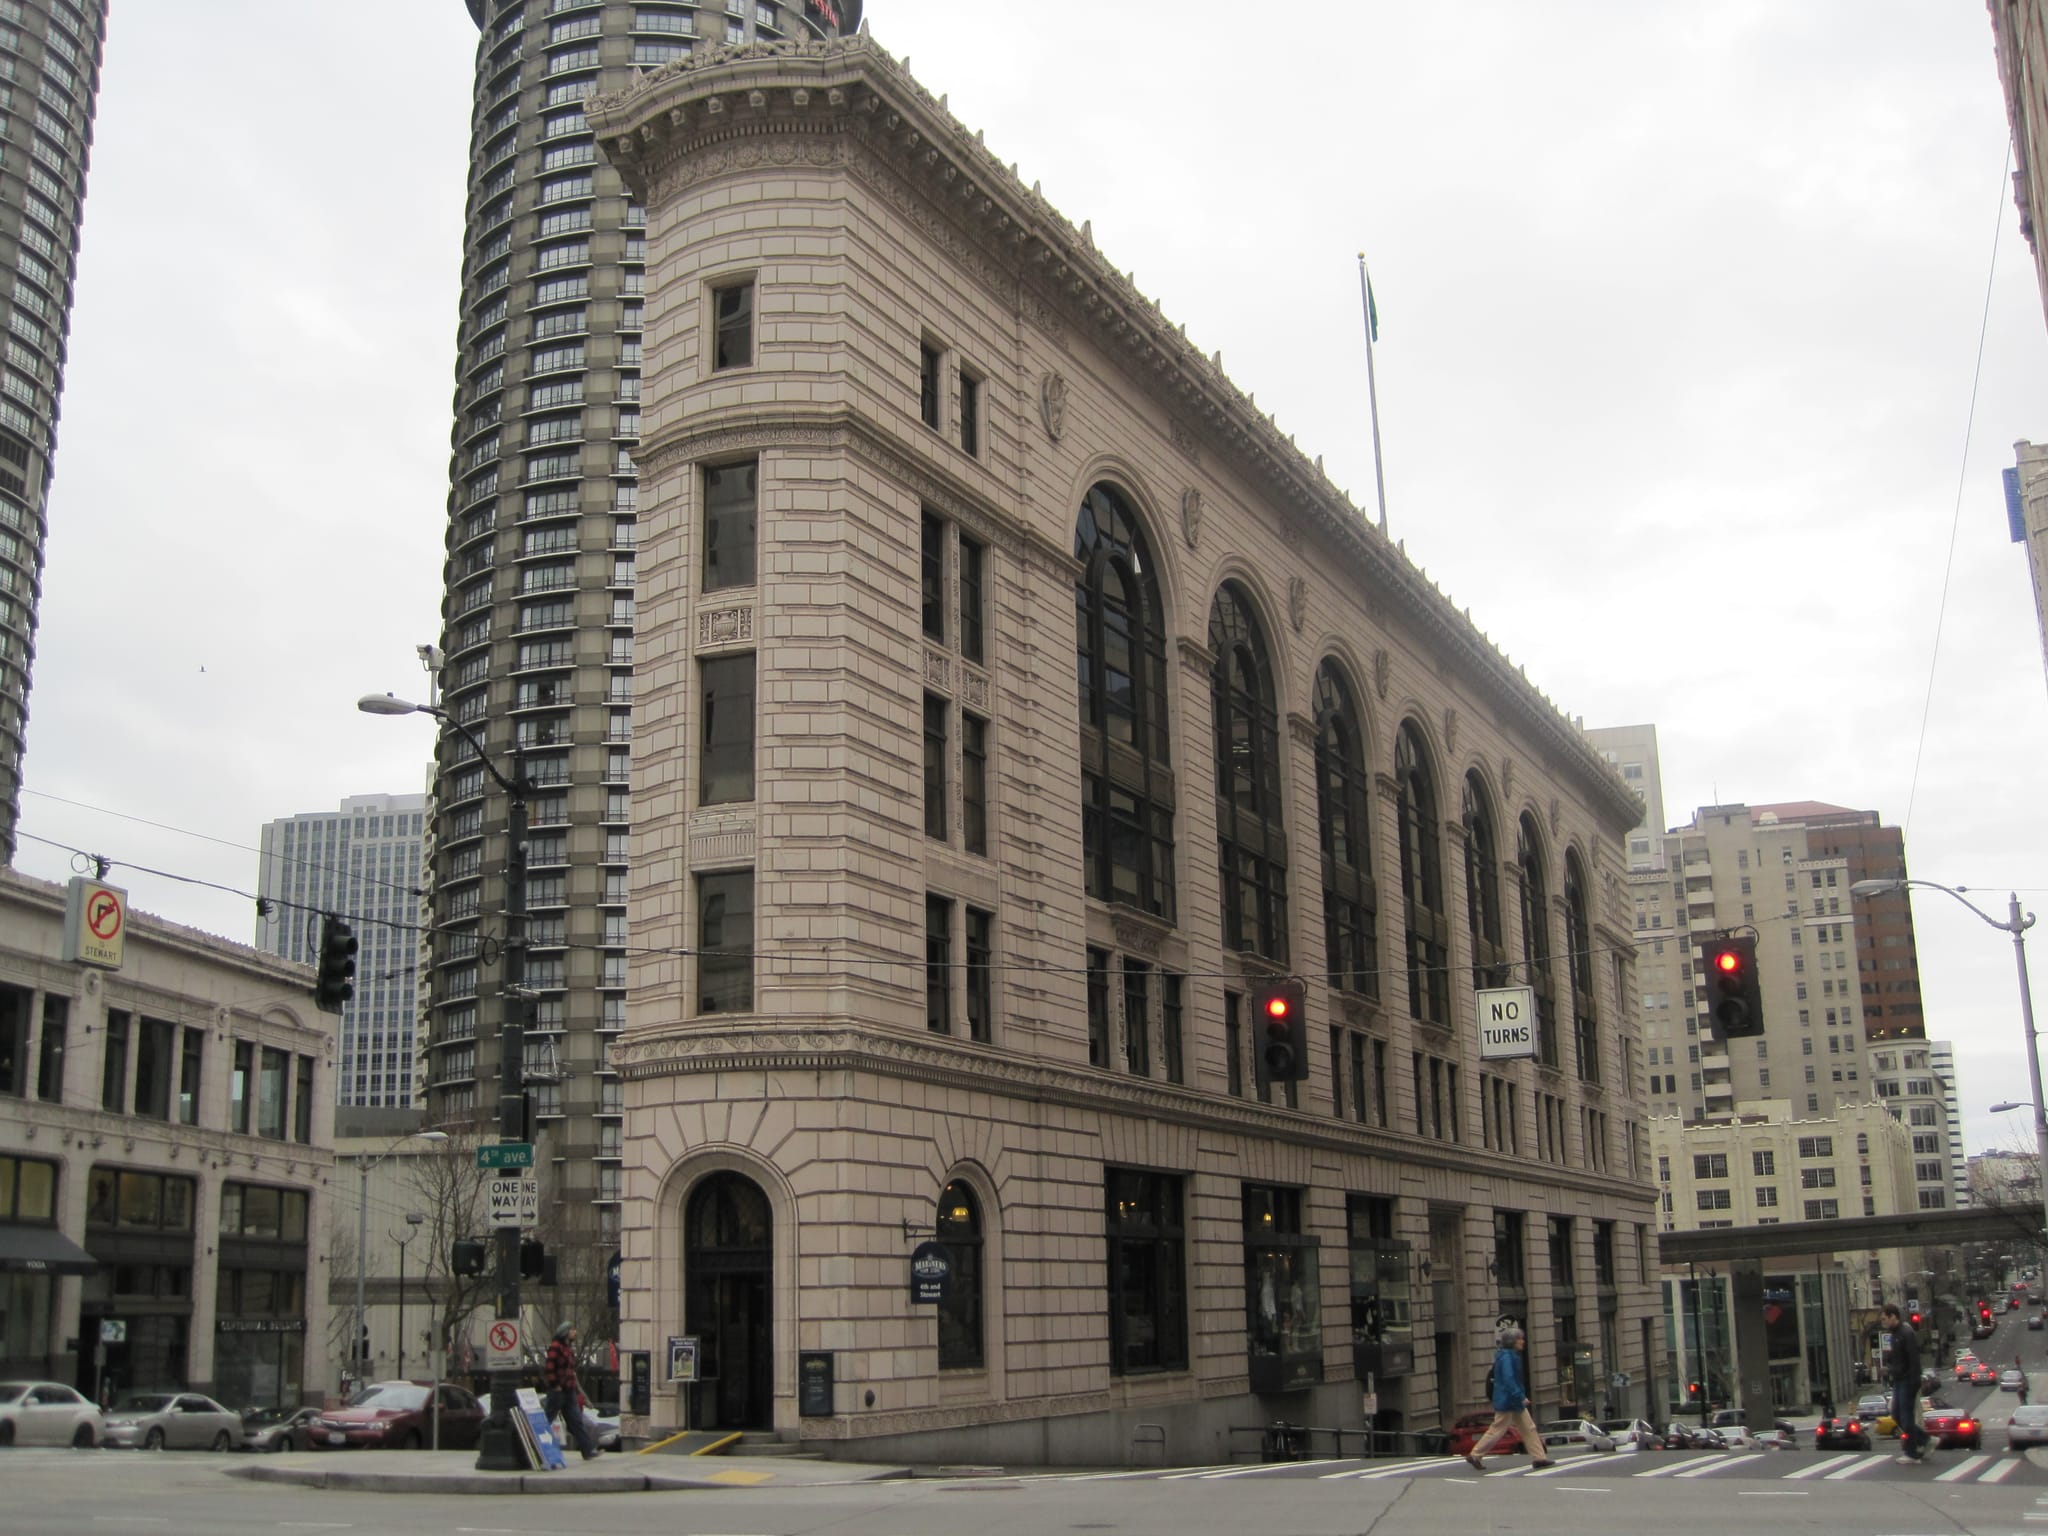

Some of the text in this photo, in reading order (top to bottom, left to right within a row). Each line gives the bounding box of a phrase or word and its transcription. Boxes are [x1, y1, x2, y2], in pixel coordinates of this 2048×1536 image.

[85, 945, 117, 961] STEWART
[1491, 1001, 1519, 1021] NO
[1484, 1027, 1529, 1044] TURNS
[492, 1182, 519, 1193] ONE
[491, 1195, 519, 1207] WAY
